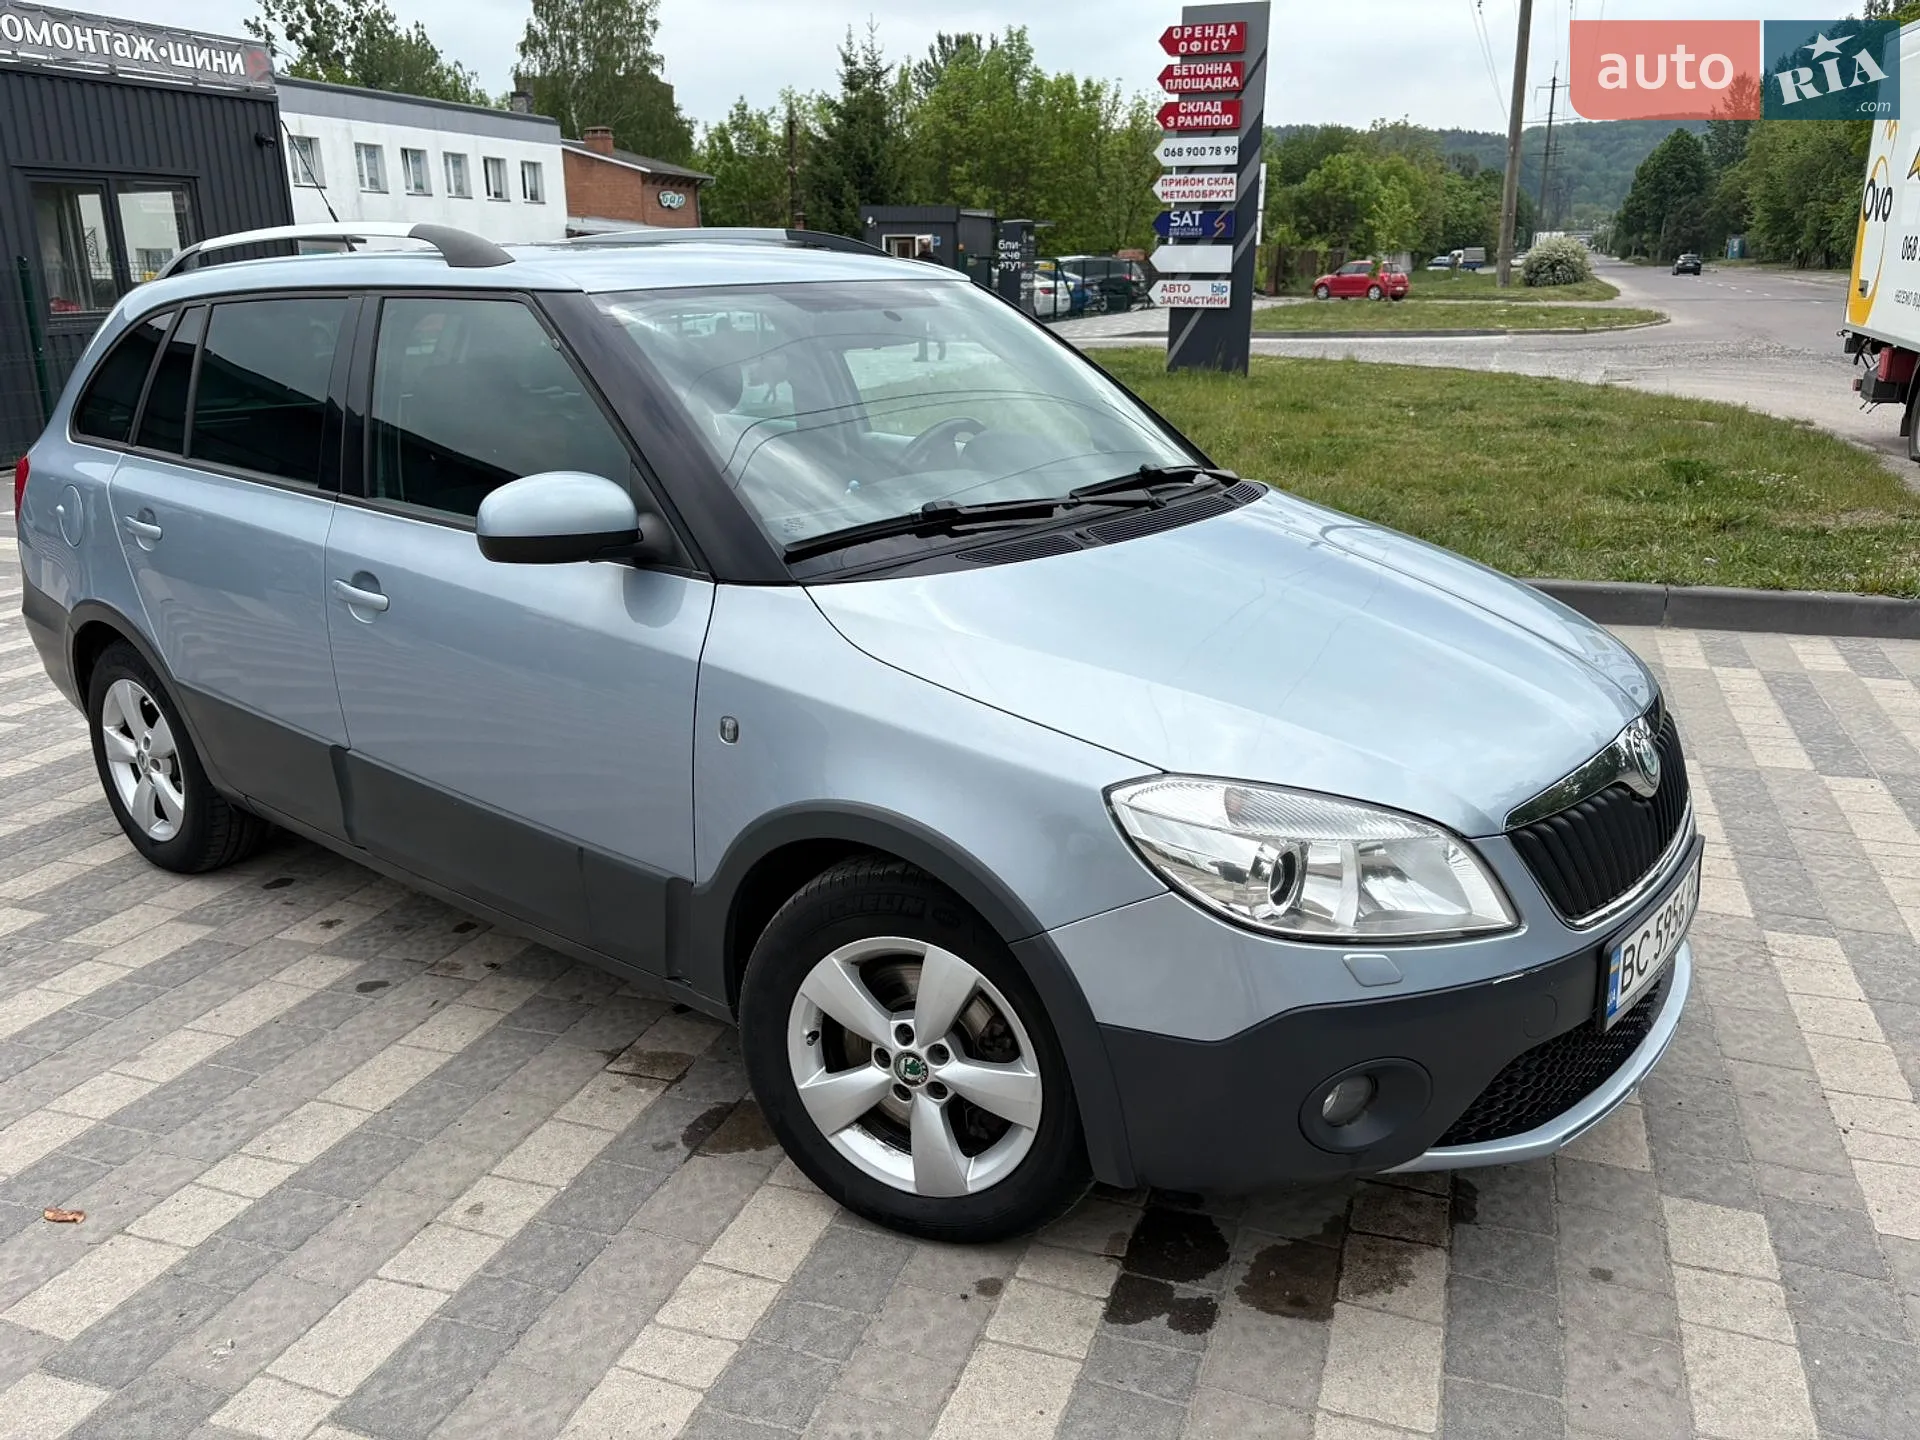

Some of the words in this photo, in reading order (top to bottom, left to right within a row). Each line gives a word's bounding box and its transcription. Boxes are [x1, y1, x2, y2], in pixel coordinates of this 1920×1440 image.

[0, 14, 161, 63] омонтаж
[1172, 24, 1238, 40] ОРЕНДА
[1178, 40, 1231, 54] ОФІСУ
[1173, 62, 1233, 76] БЕТОННА
[1165, 77, 1240, 90] ПЛОЩАДКА
[1179, 102, 1222, 114] СКЛАД
[1177, 114, 1233, 127] РАМПОЮ
[1163, 147, 1183, 158] 068
[1186, 147, 1206, 157] 900
[1209, 146, 1222, 157] 78
[1225, 145, 1238, 156] 99
[1161, 176, 1204, 187] ПРИЙОМ
[1207, 176, 1235, 187] СКЛА
[1161, 189, 1234, 199] МЕТАЛОБРУХТ
[1170, 210, 1203, 227] SAT
[1901, 235, 1918, 261] 068
[1160, 284, 1191, 294] АВТО
[1159, 295, 1228, 305] ЗАПЧАСТИНИ
